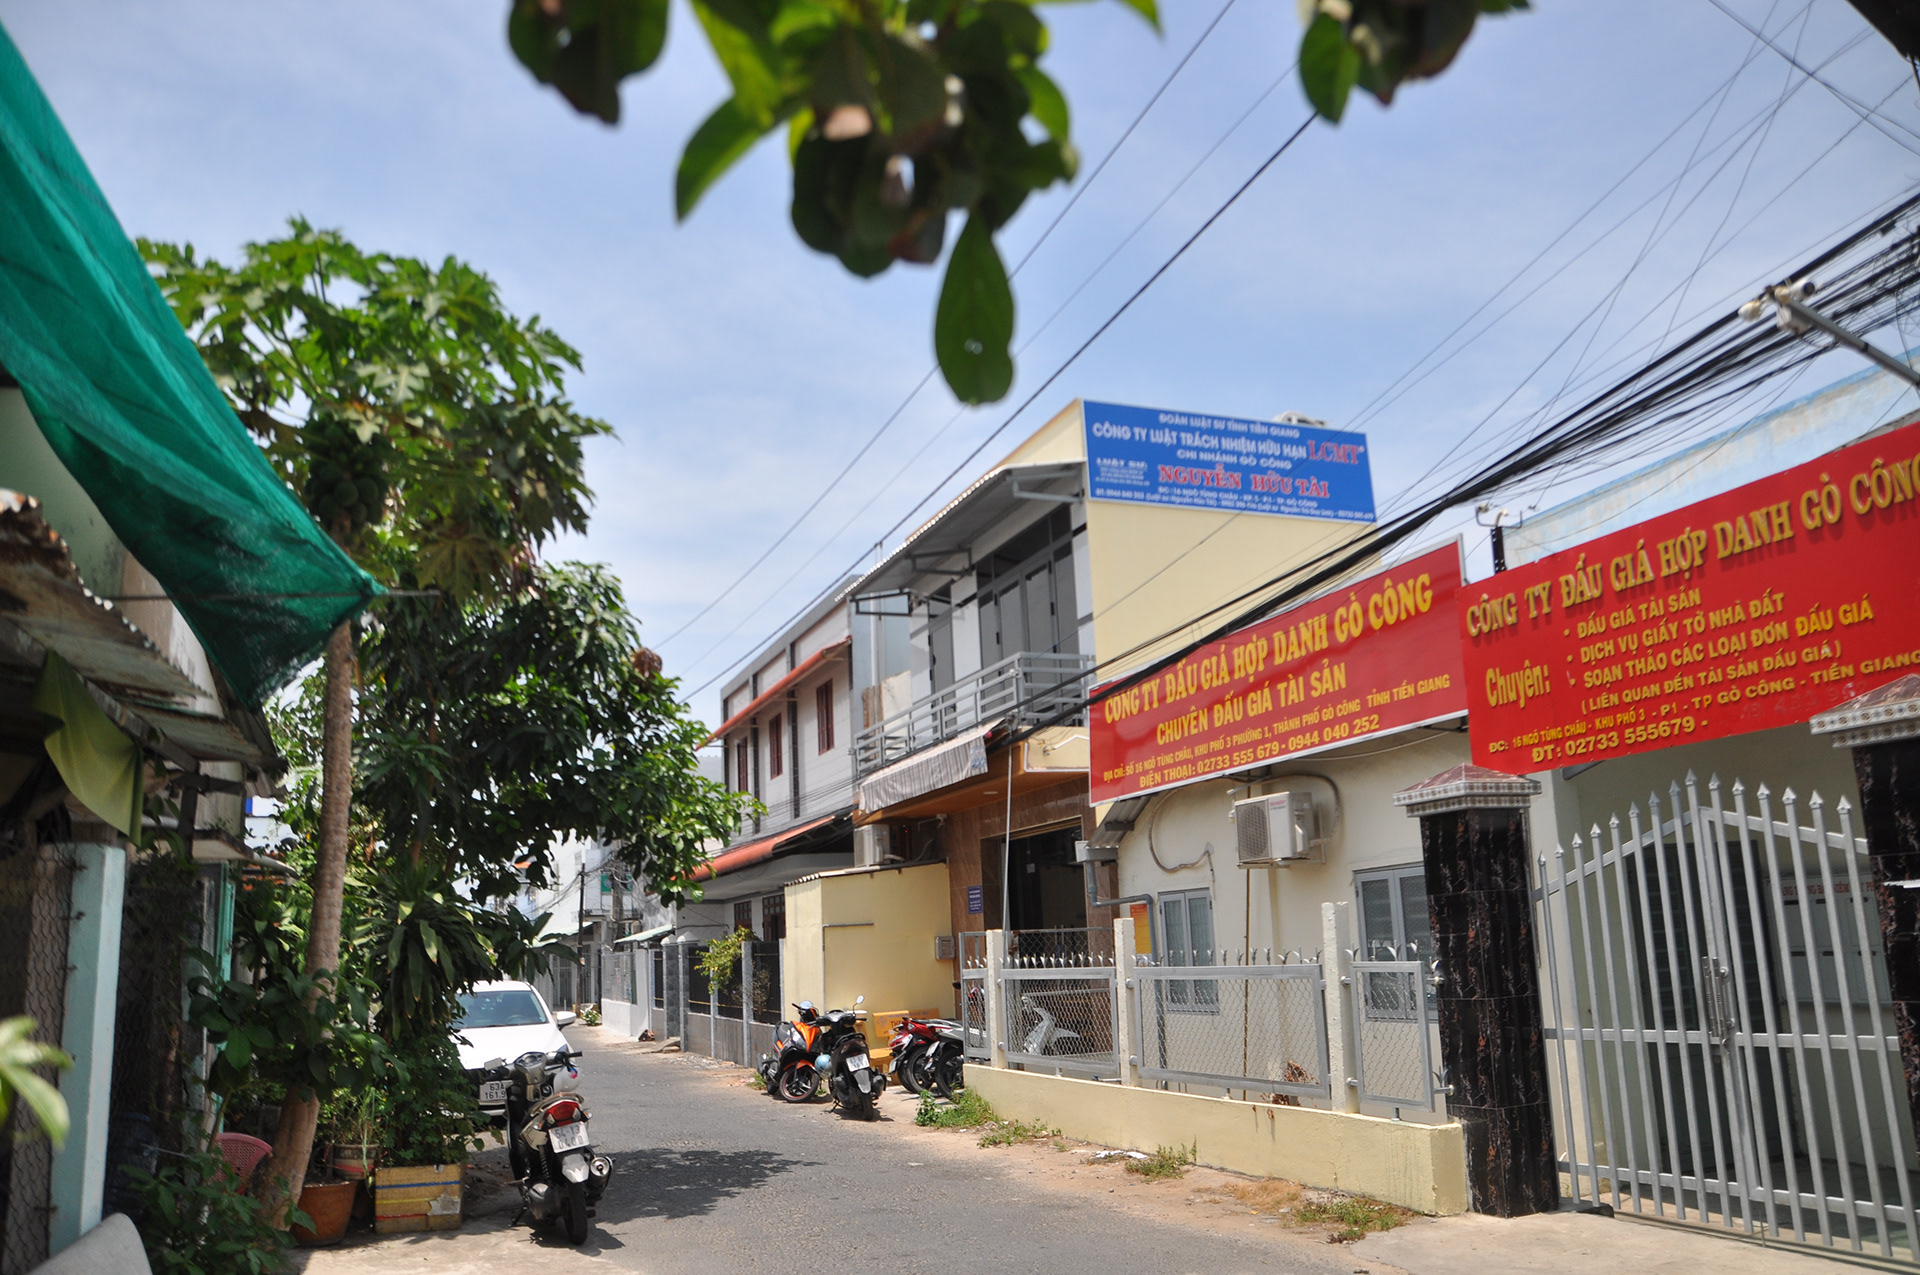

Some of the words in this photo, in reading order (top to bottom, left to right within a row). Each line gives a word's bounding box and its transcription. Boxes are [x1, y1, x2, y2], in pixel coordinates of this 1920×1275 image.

[1092, 421, 1131, 440] CÔNG
[1133, 426, 1147, 441] TY
[1149, 428, 1177, 446] LUẬT
[1179, 431, 1219, 449] TRÁCH
[1222, 436, 1256, 454] NHIỆM
[1258, 438, 1280, 456] HỮU
[1282, 443, 1307, 460] HẠN
[1177, 448, 1197, 460] CHI
[1200, 450, 1238, 464] NHÁNH
[1260, 456, 1292, 470] CÔNG
[1270, 426, 1300, 439] GIANG
[1158, 462, 1242, 490] NGUYỄN
[1250, 470, 1293, 494] HỮU
[1295, 475, 1330, 498] TÀI
[1466, 593, 1518, 637] CÔNG
[1524, 580, 1552, 619] TY
[1559, 552, 1602, 608] ĐẤU
[1610, 538, 1655, 593] GIÁ
[1657, 525, 1707, 580] HỢP
[1713, 500, 1794, 559] DANH
[1800, 472, 1842, 530] GÒ
[1577, 611, 1606, 639] ĐẤU
[1610, 605, 1636, 630] GIÁ
[1638, 596, 1665, 620] TÀI
[1667, 586, 1701, 612] SẢN
[1580, 638, 1615, 666] DỊCH
[1618, 634, 1638, 656] VỤ
[1642, 618, 1679, 647] GIẤY
[1683, 609, 1706, 636] TỜ
[1708, 600, 1747, 630] NHÀ
[1749, 587, 1784, 619] ĐẤT
[1141, 678, 1161, 711] TY
[1165, 657, 1198, 703] ĐẤU
[1201, 644, 1230, 690] GIÁ
[1232, 634, 1268, 683] HỢP
[1273, 613, 1329, 666] DANH
[1334, 592, 1364, 643] GÒ
[1368, 573, 1433, 630] CÔNG
[1583, 662, 1623, 689] SOẠN
[1626, 650, 1667, 677] THẢO
[1671, 641, 1704, 667] CÁC
[1708, 632, 1747, 658] LOẠI
[1751, 621, 1789, 647] ĐƠN
[1795, 603, 1834, 637] ĐẤU
[1838, 593, 1874, 626] GIÁ
[1156, 705, 1209, 745] CHUYÊN
[1214, 690, 1244, 728] ĐẤU
[1246, 681, 1273, 717] GIÁ
[1277, 674, 1305, 708] TÀI
[1310, 658, 1347, 698] SẢN
[1485, 659, 1551, 709] Chuyên:
[1622, 686, 1661, 704] QUAN
[1664, 672, 1694, 695] ĐẾN
[1697, 666, 1723, 688] TÀI
[1726, 658, 1760, 681] SẢN
[1762, 648, 1797, 672] ĐẤU
[1103, 770, 1114, 783] ĐỊA
[1126, 760, 1135, 776] SỐ
[1135, 761, 1143, 773] 16
[1143, 755, 1156, 770] NGÔ
[1157, 751, 1174, 766] TÙNG
[1194, 743, 1208, 756] KHU
[1209, 734, 1225, 752] PHỐ
[1226, 737, 1232, 748] 3
[1232, 726, 1263, 746] PHƯỜNG
[1264, 726, 1272, 740] 1,
[1273, 716, 1300, 735] THÀNH
[1302, 706, 1320, 727] PHỐ
[1321, 703, 1334, 721] GÒ
[1336, 698, 1361, 718] CÔNG
[1366, 688, 1391, 708] TỈNH
[1417, 673, 1451, 695] GIANG
[1489, 741, 1509, 754] ĐC:
[1512, 736, 1522, 748] 16
[1522, 729, 1539, 746] NGÔ
[1540, 725, 1563, 741] TÙNG
[1564, 719, 1586, 736] CHÂU
[1595, 714, 1615, 730] KHU
[1616, 705, 1637, 726] PHỐ
[1639, 708, 1646, 721] 3
[1660, 701, 1678, 717] P1
[1691, 693, 1712, 709] TP
[1717, 685, 1742, 705] GÒ
[1745, 676, 1796, 698] CÔNG
[1565, 733, 1620, 757] 02733
[1624, 716, 1696, 744] 555679
[1140, 769, 1162, 788] ĐIỆN
[1164, 764, 1196, 783] THOẠI:
[1197, 755, 1231, 774] 02733
[1232, 749, 1254, 766] 555
[1256, 741, 1279, 759] 679
[1288, 730, 1320, 751] 0944
[1323, 722, 1350, 742] 040
[1353, 714, 1380, 735] 252
[490, 1082, 505, 1091] 63A
